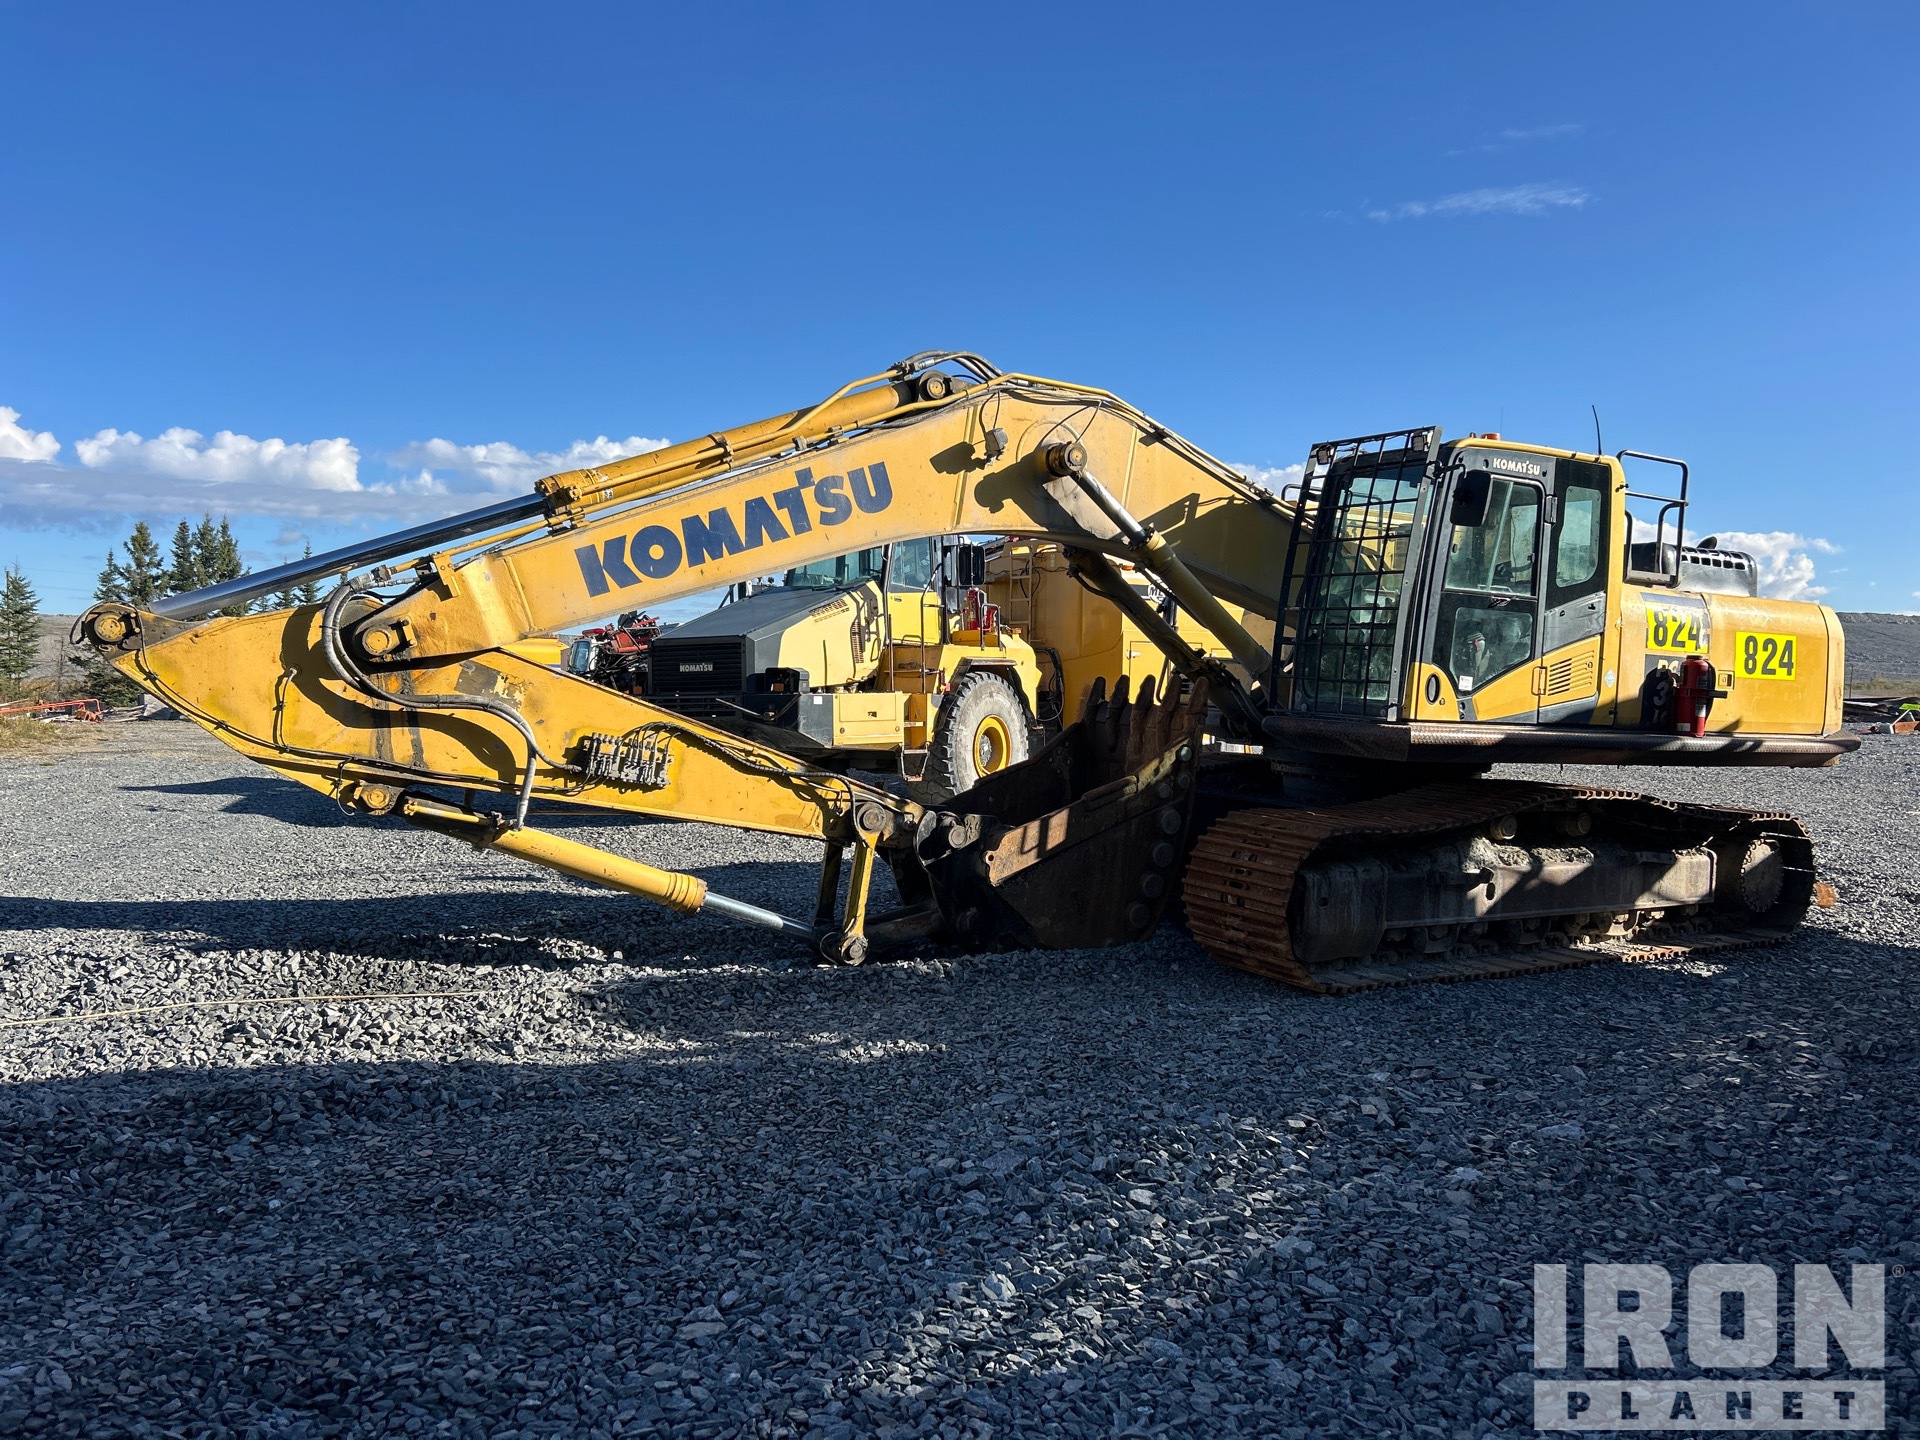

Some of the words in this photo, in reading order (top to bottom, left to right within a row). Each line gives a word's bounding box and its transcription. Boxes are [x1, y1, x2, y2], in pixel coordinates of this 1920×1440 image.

[1493, 458, 1541, 475] KOMATSU
[574, 461, 893, 598] KOMATSU
[1654, 609, 1701, 651] 824
[680, 663, 713, 673] KOMATSU
[1744, 635, 1794, 676] 824
